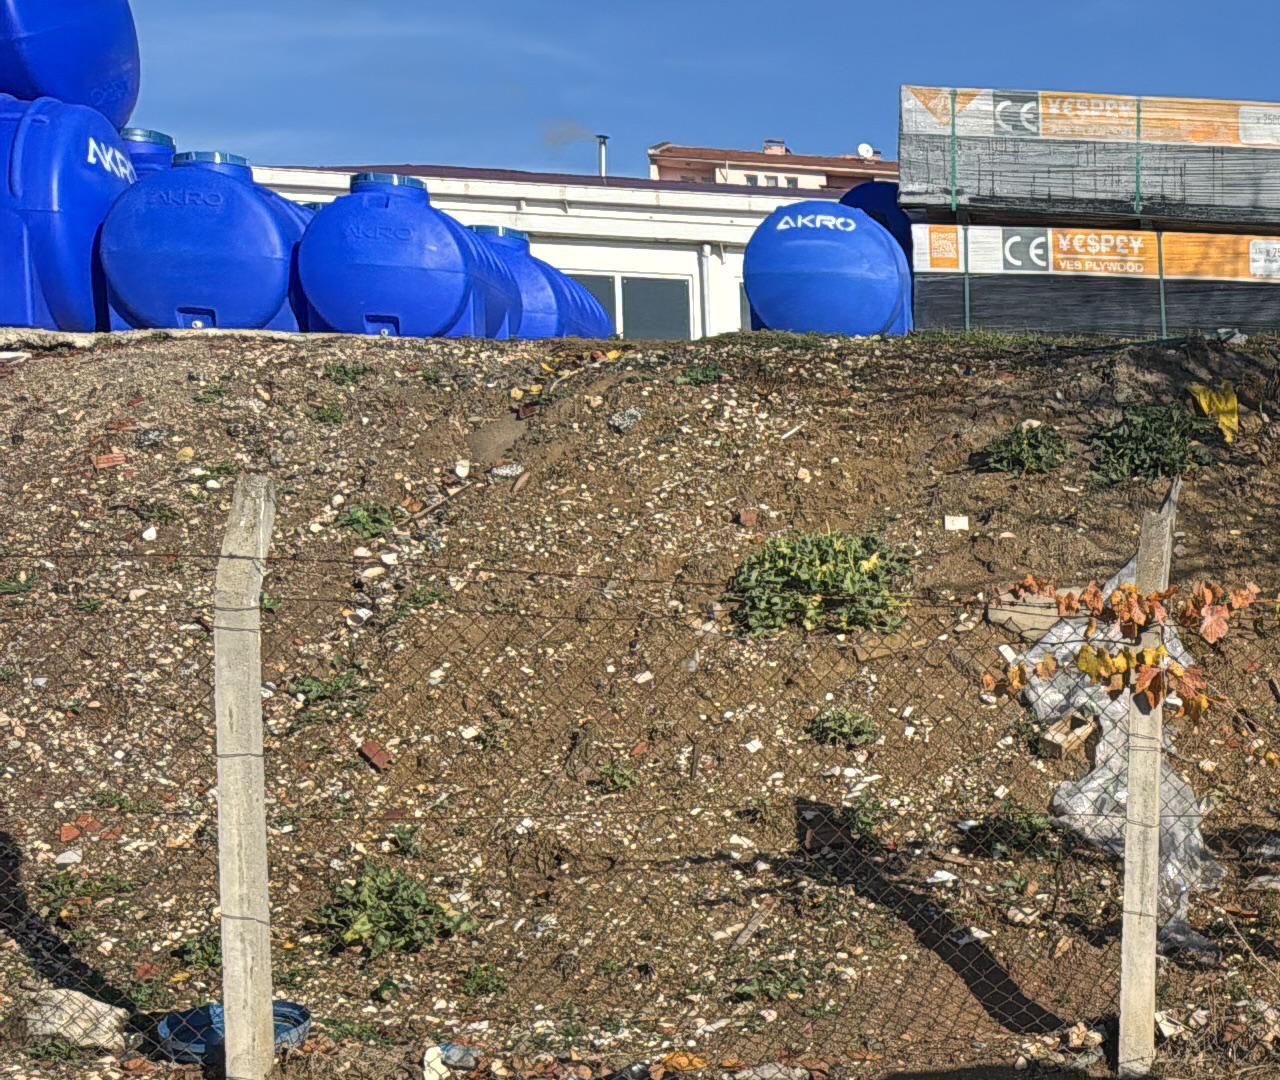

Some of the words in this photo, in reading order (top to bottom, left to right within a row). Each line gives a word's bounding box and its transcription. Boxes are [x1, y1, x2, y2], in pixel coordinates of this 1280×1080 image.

[776, 214, 857, 232] AKRO
[1059, 260, 1083, 271] YES
[1085, 261, 1145, 273] PLYWOOD
